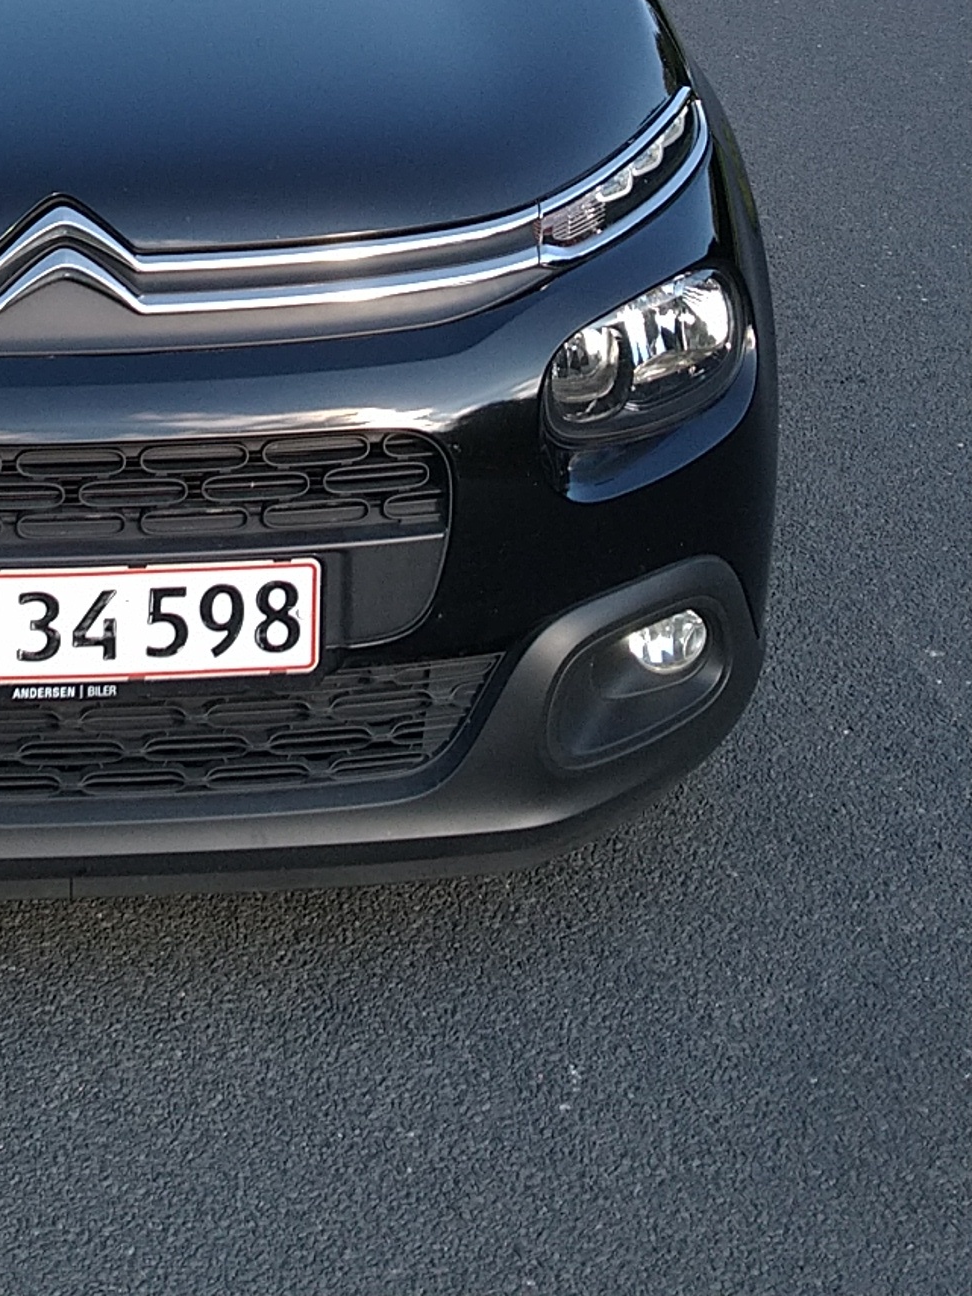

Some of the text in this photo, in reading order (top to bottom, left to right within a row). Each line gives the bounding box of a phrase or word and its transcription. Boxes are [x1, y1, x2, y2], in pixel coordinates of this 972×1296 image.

[16, 590, 117, 662] 34
[145, 580, 301, 658] 598
[12, 684, 117, 700] ANDERSEN BILER
